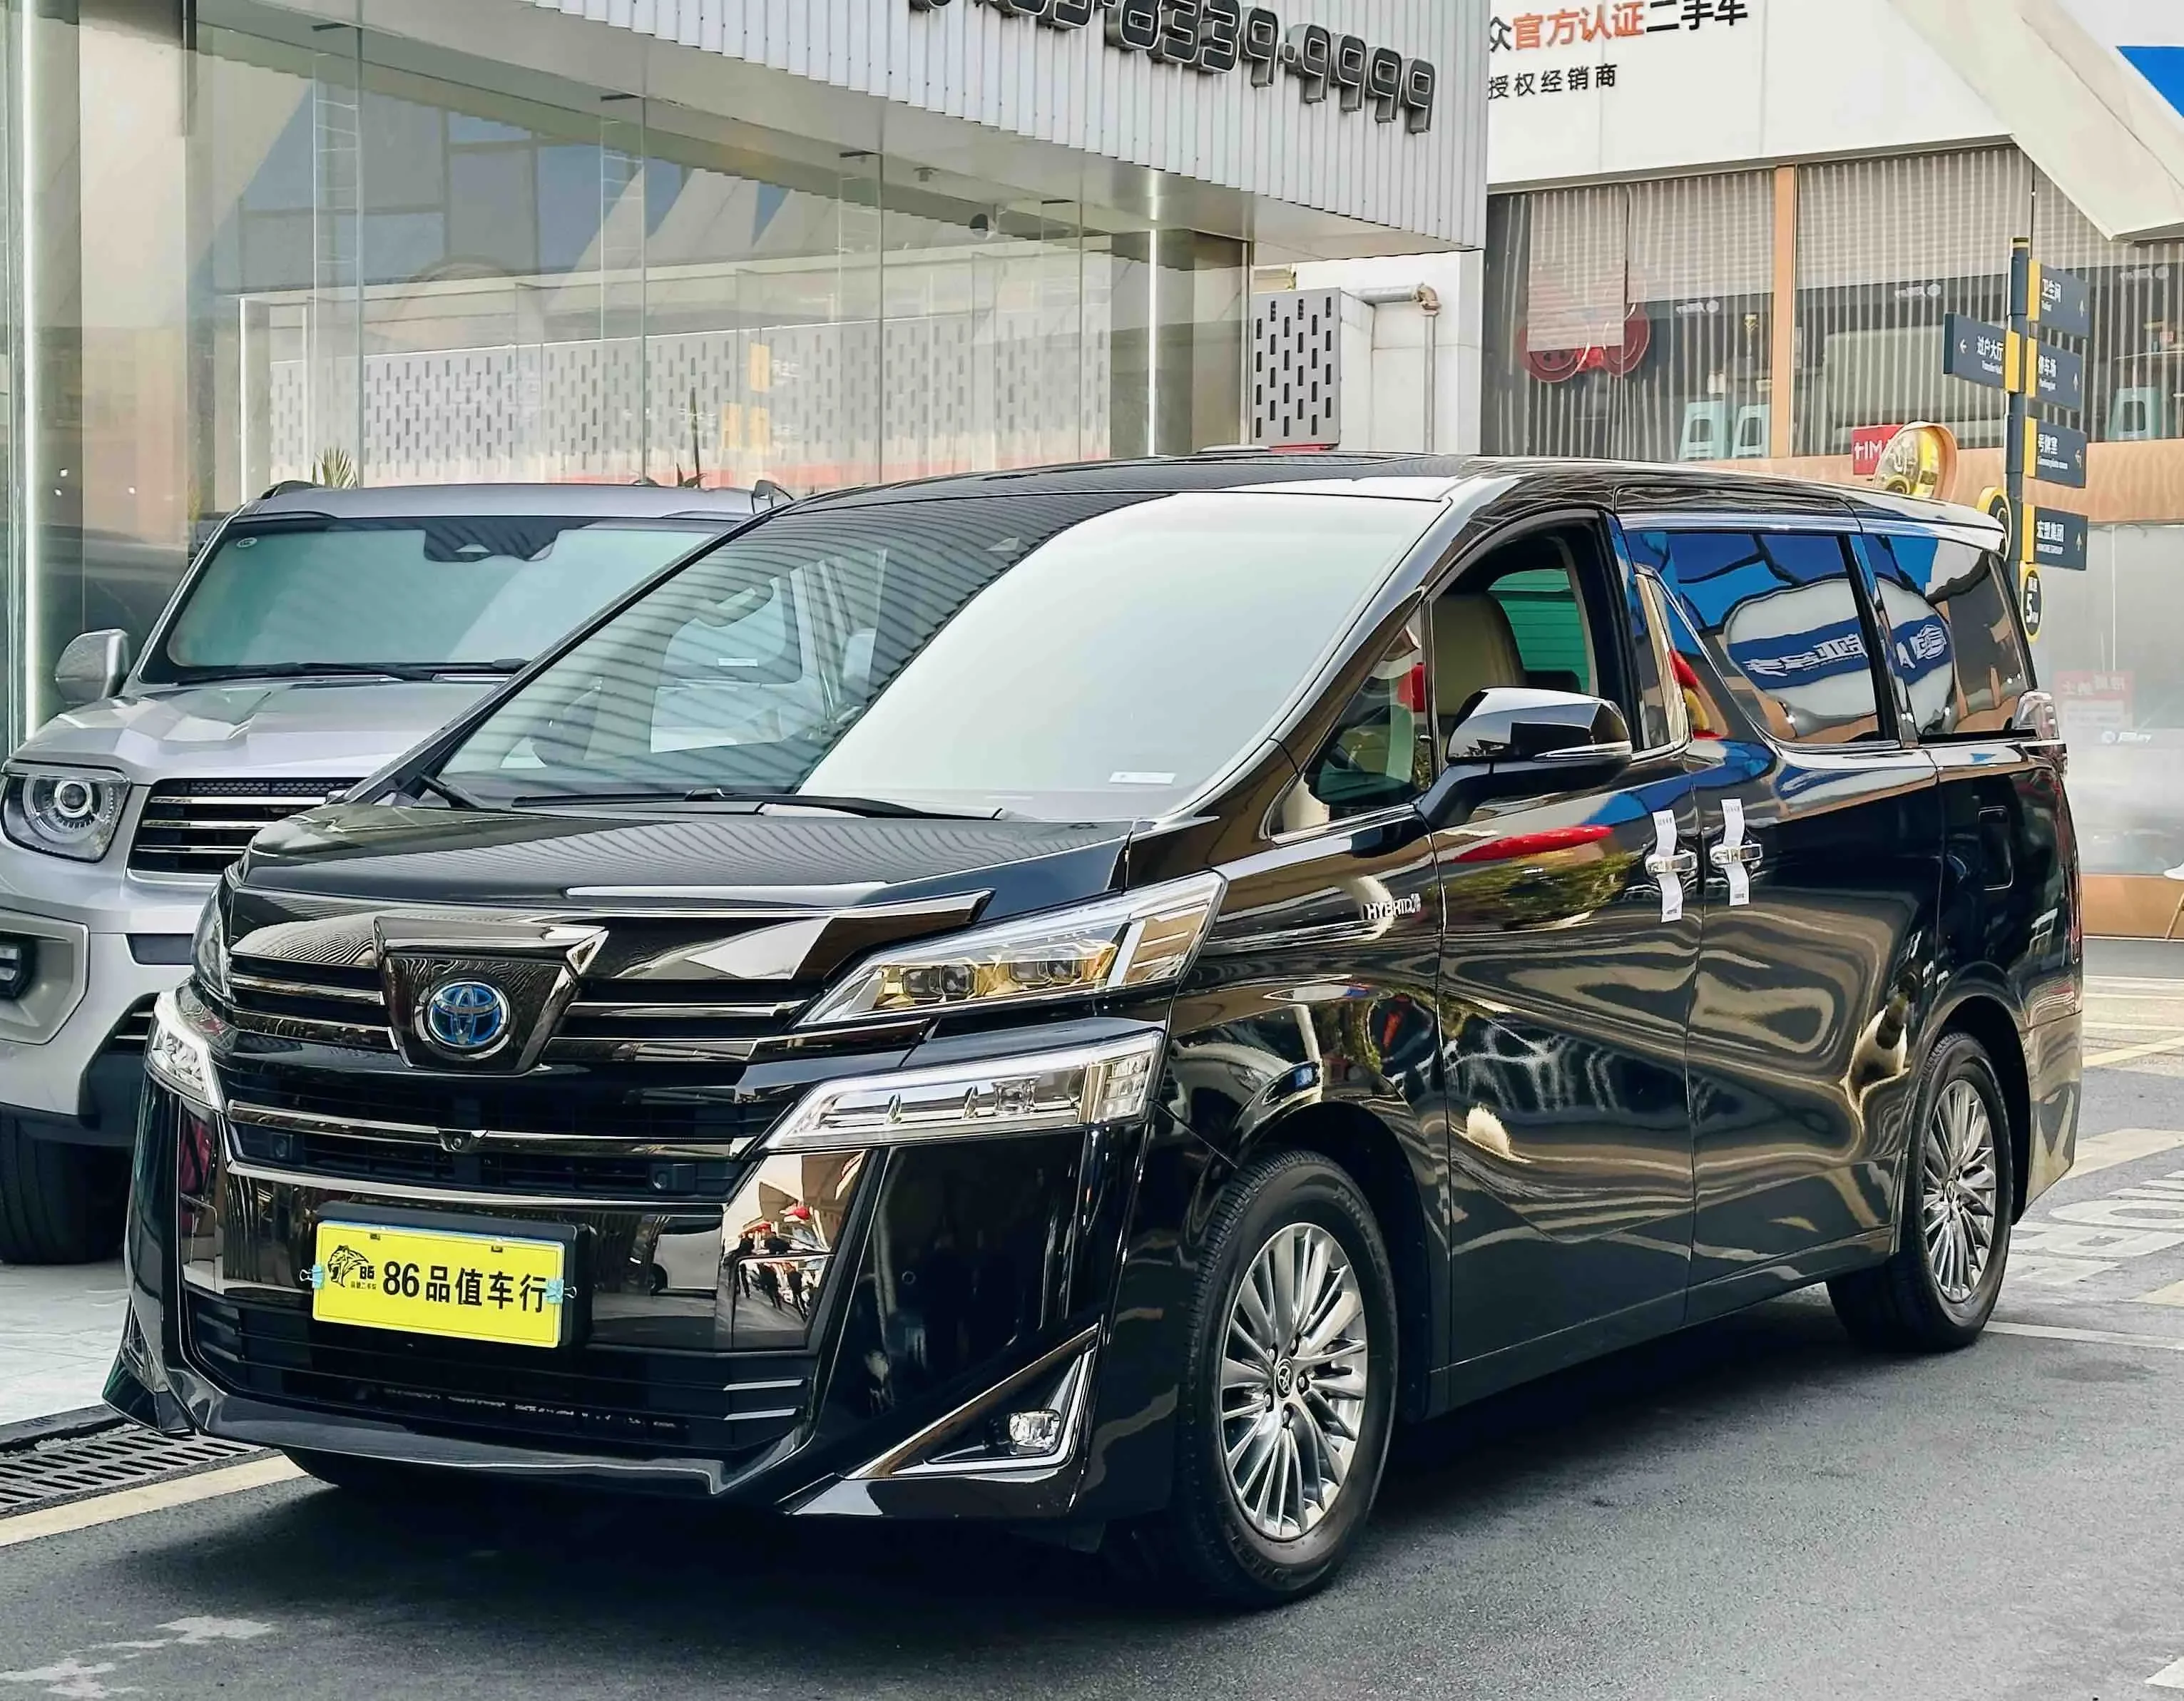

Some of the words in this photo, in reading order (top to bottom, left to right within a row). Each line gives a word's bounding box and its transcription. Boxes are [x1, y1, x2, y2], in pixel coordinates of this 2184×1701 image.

[1488, 63, 1618, 100] 授权经销商
[1365, 897, 1415, 920] HYBRID
[359, 1265, 375, 1279] 86
